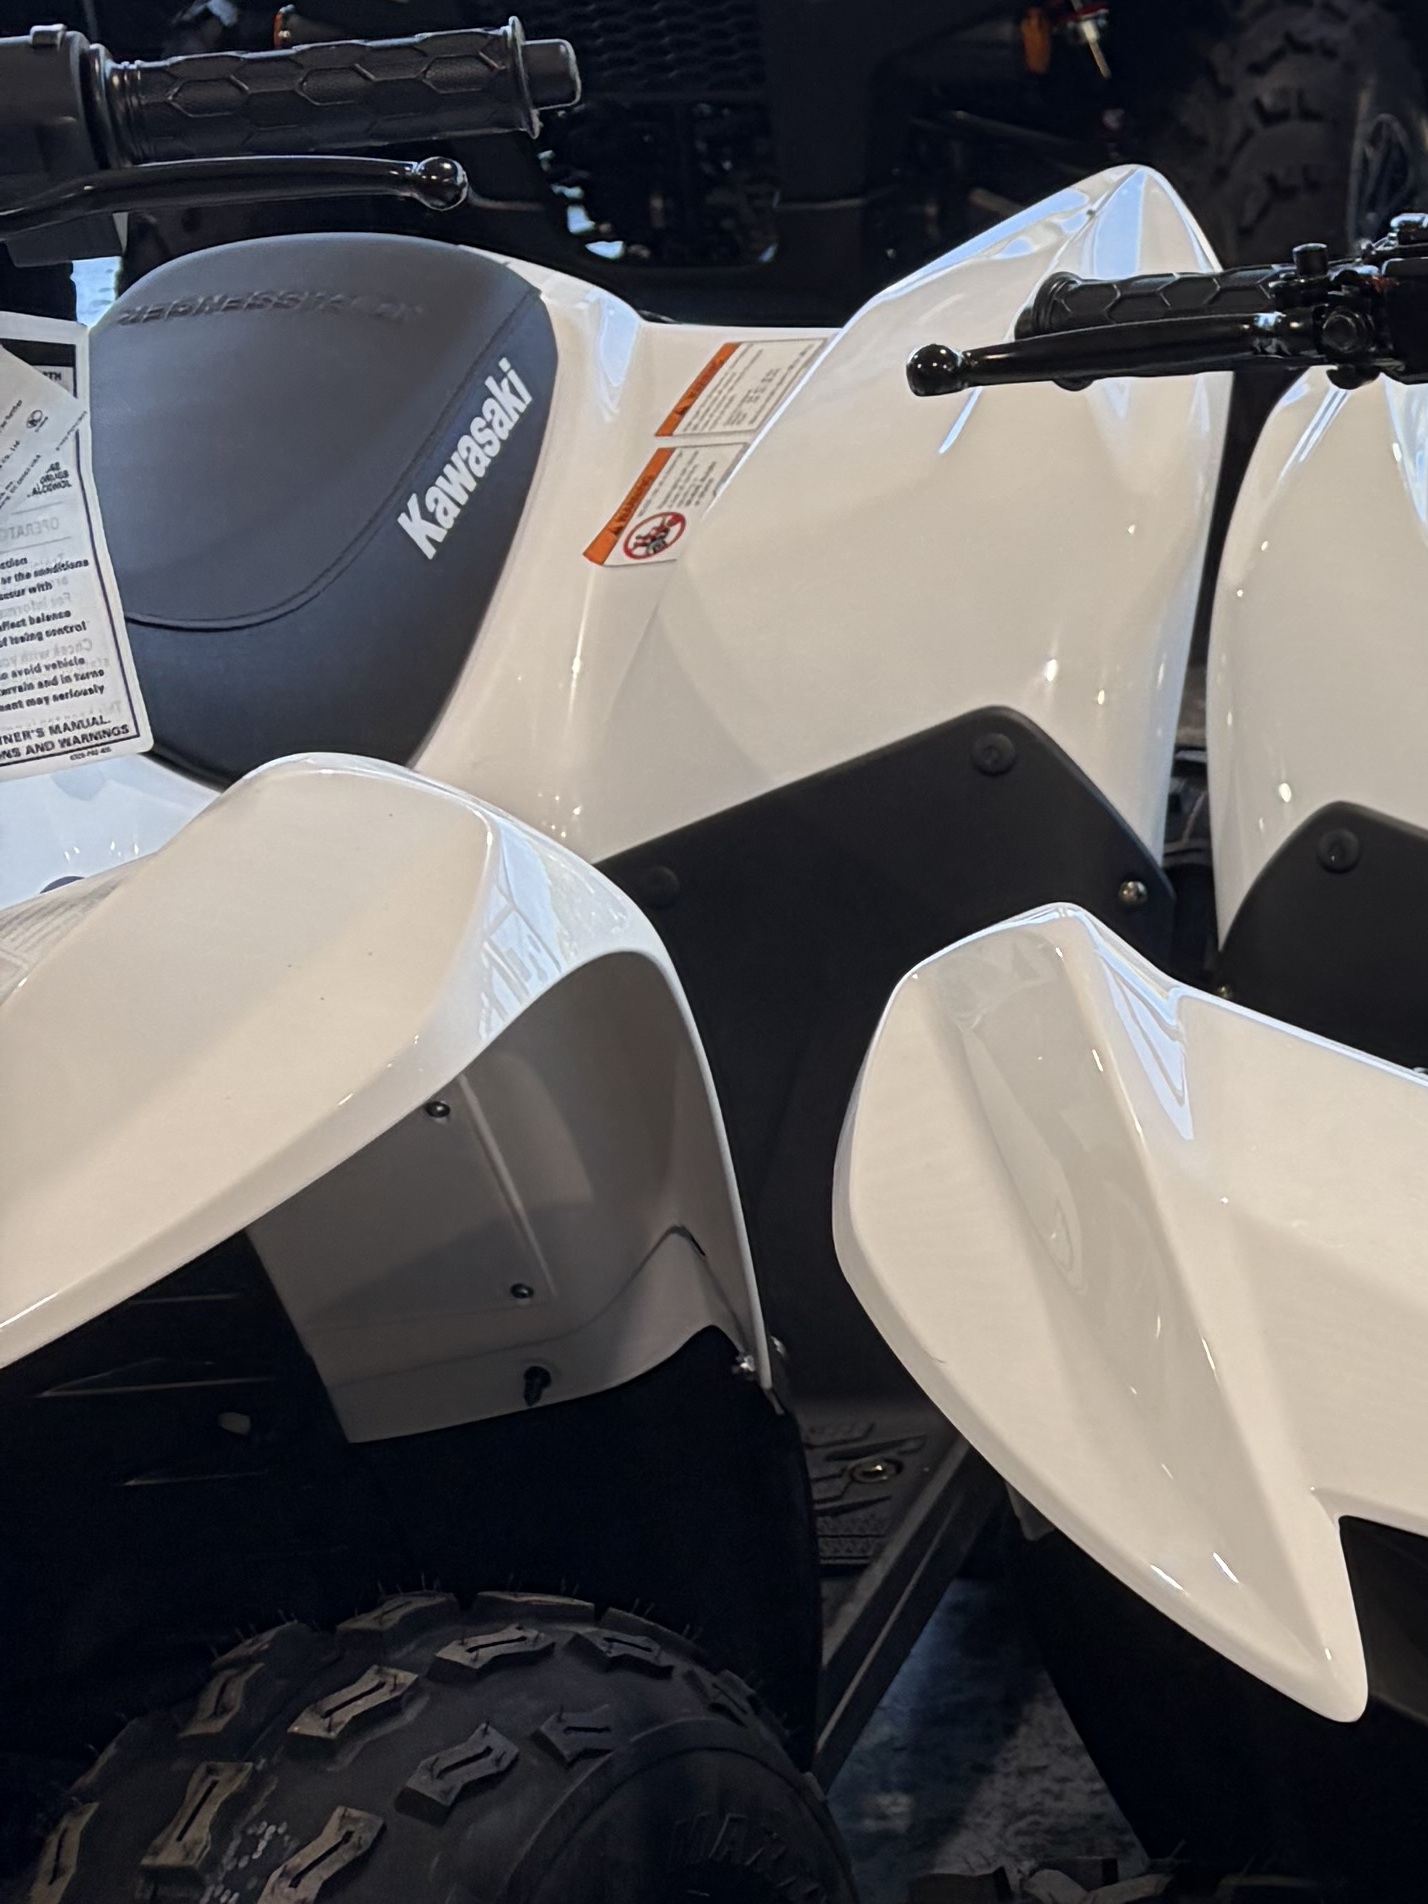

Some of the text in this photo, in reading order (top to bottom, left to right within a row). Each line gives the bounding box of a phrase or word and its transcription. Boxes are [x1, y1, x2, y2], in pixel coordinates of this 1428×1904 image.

[397, 357, 534, 560] Kawasaki
[14, 571, 32, 582] the
[28, 581, 53, 594] with
[10, 662, 42, 678] avoid
[37, 674, 59, 688] and
[24, 739, 56, 757] AND
[57, 723, 130, 751] WARNINGS
